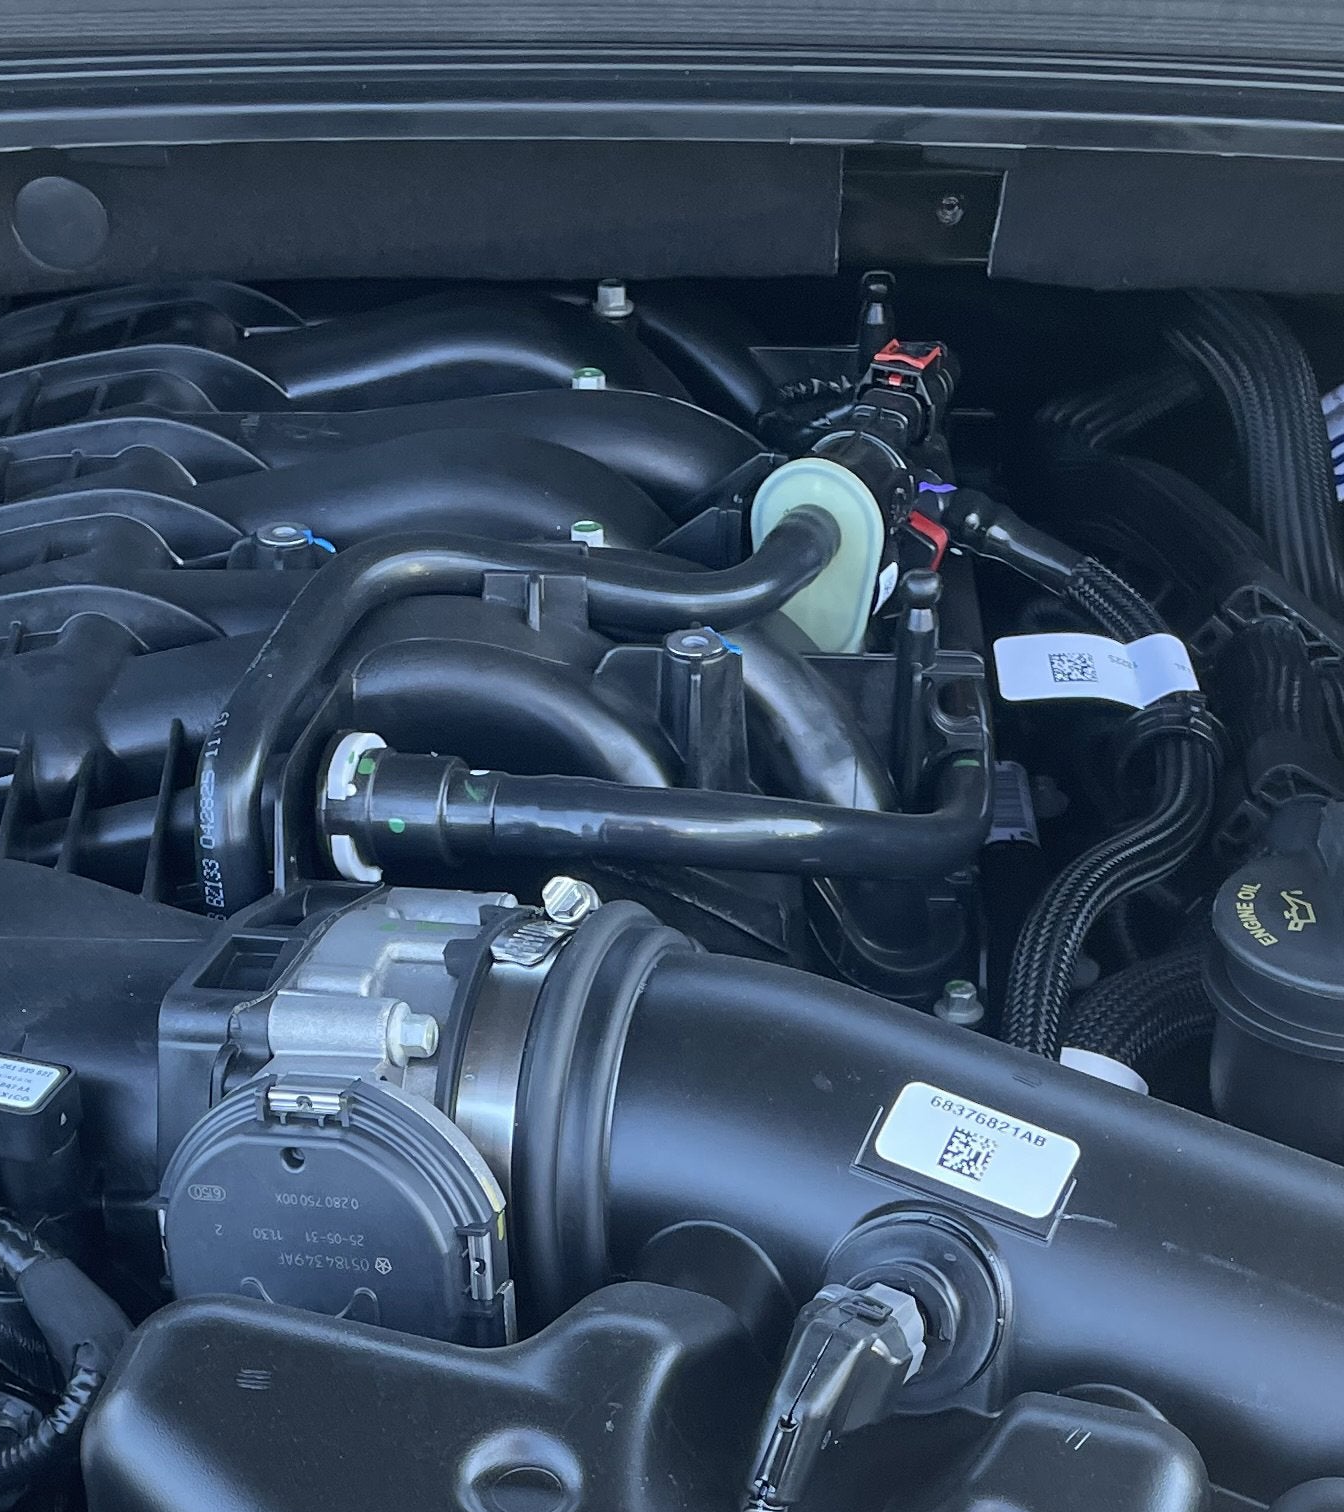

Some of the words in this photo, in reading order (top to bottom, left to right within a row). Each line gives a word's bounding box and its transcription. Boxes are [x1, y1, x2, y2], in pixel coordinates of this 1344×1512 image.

[199, 769, 216, 850] 042825
[1237, 882, 1262, 900] OIL
[1236, 902, 1278, 946] ENGINE
[930, 1095, 1047, 1147] 68376821AB
[214, 1224, 223, 1236] 2
[305, 1231, 364, 1246] 25-05-31
[278, 1252, 370, 1272] 05184349AF
